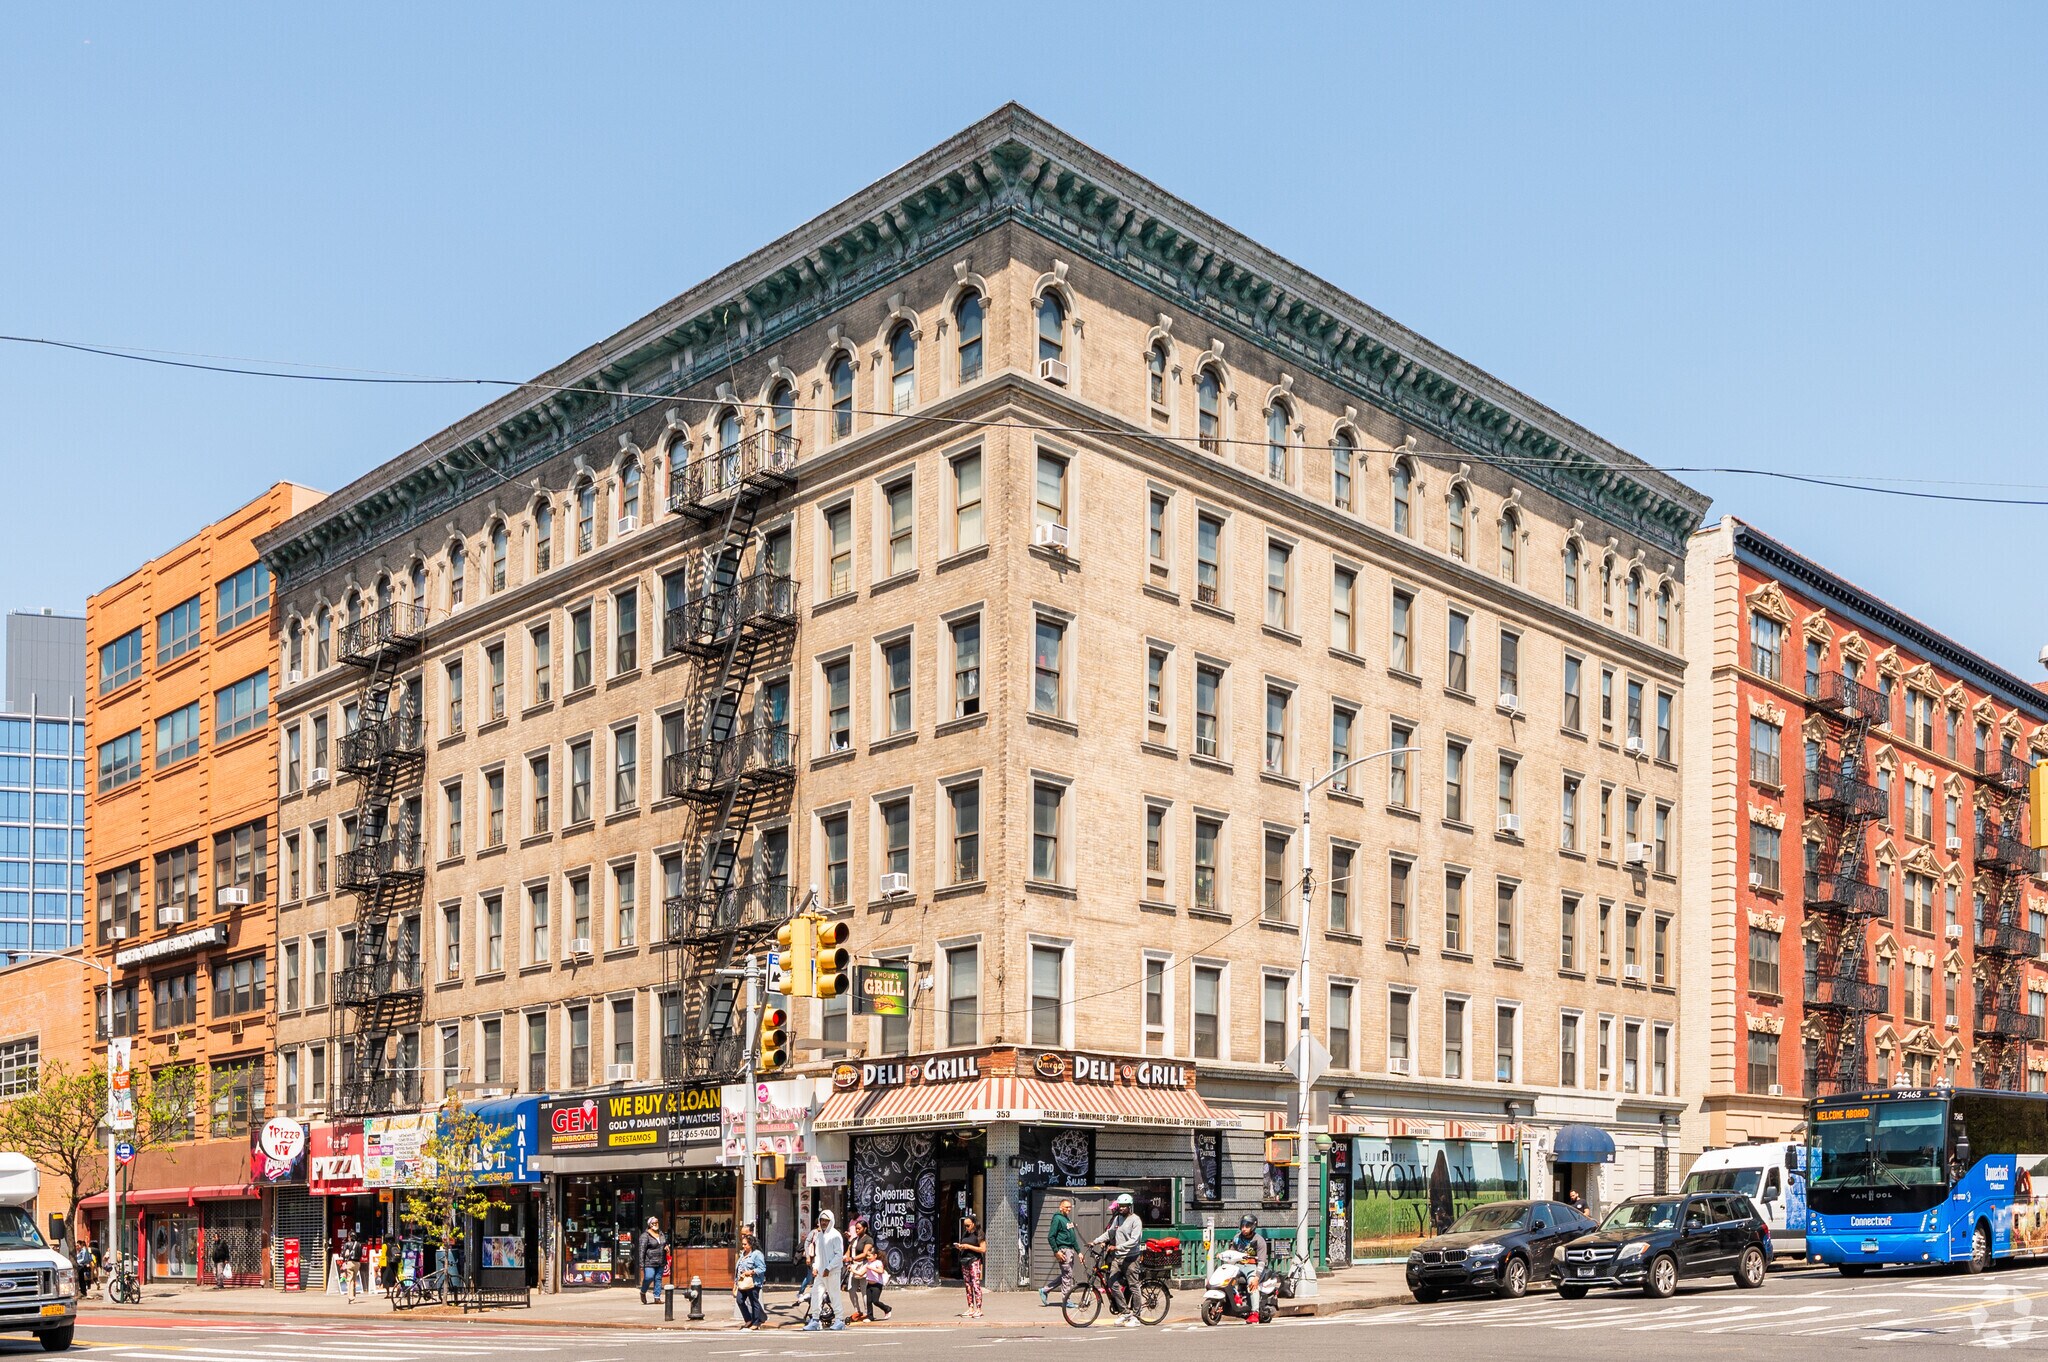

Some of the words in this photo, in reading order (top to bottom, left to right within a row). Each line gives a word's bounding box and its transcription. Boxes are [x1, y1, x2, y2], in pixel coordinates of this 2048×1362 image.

[879, 972, 899, 980] HOURS
[864, 978, 904, 997] GRILL
[864, 1064, 904, 1086] DELI
[924, 1057, 979, 1081] GRILL
[1037, 1060, 1063, 1074] Omega
[1075, 1056, 1115, 1082] DELI
[1138, 1061, 1187, 1086] GRILL
[1897, 1090, 1921, 1099] 75465
[609, 1096, 632, 1117] WE
[634, 1093, 664, 1115] BUY
[665, 1092, 678, 1112] &
[680, 1088, 721, 1111] LOAN
[551, 1105, 599, 1134] GEM
[721, 1105, 767, 1124] Perft
[768, 1103, 806, 1121] Brows
[866, 1118, 877, 1126] SOUP
[880, 1116, 895, 1125] CREATE
[896, 1115, 907, 1124] YOUR
[908, 1115, 918, 1123] OWN
[919, 1114, 933, 1122] SALAD
[936, 1113, 947, 1121] OPEN
[948, 1111, 965, 1120] BUFFET
[996, 1110, 1011, 1119] 353
[1043, 1110, 1060, 1119] FRESH
[1060, 1112, 1074, 1120] JUICE
[1078, 1113, 1106, 1121] HOMEMADE
[1106, 1114, 1119, 1122] SOUP
[1123, 1115, 1140, 1124] CREATE
[1141, 1116, 1153, 1124] YOUR
[1154, 1117, 1165, 1125] OWN
[1166, 1117, 1181, 1126] SALAD
[1183, 1118, 1195, 1127] OPEN
[1196, 1119, 1211, 1127] BUFFET
[1817, 1110, 1844, 1120] WELCOME
[1846, 1108, 1870, 1118] ABOARD
[608, 1121, 628, 1131] GOLD
[636, 1117, 676, 1128] DIAMONDS
[686, 1113, 721, 1124] WATCHES
[269, 1125, 301, 1140] iPizza
[552, 1134, 599, 1143] PAWNBROKERS
[614, 1134, 652, 1143] PRESTAMOS
[671, 1129, 718, 1139] 212-665-9400
[274, 1144, 291, 1156] NY
[516, 1114, 527, 1180] NAIL
[1331, 1140, 1348, 1153] OPEN
[1335, 1151, 1346, 1162] 24
[312, 1154, 364, 1181] PIZZA
[1037, 1160, 1054, 1174] FOOD
[1065, 1175, 1087, 1186] SALADS
[1358, 1163, 1473, 1200] WOMN
[874, 1186, 915, 1204] SMOOTHIES
[881, 1201, 907, 1217] JUICES
[1401, 1207, 1411, 1219] IN
[874, 1213, 904, 1230] SALADS
[1397, 1220, 1416, 1233] THE
[1850, 1215, 1893, 1227] Connecticut
[882, 1228, 894, 1238] HOT
[896, 1227, 911, 1238] FOOD
